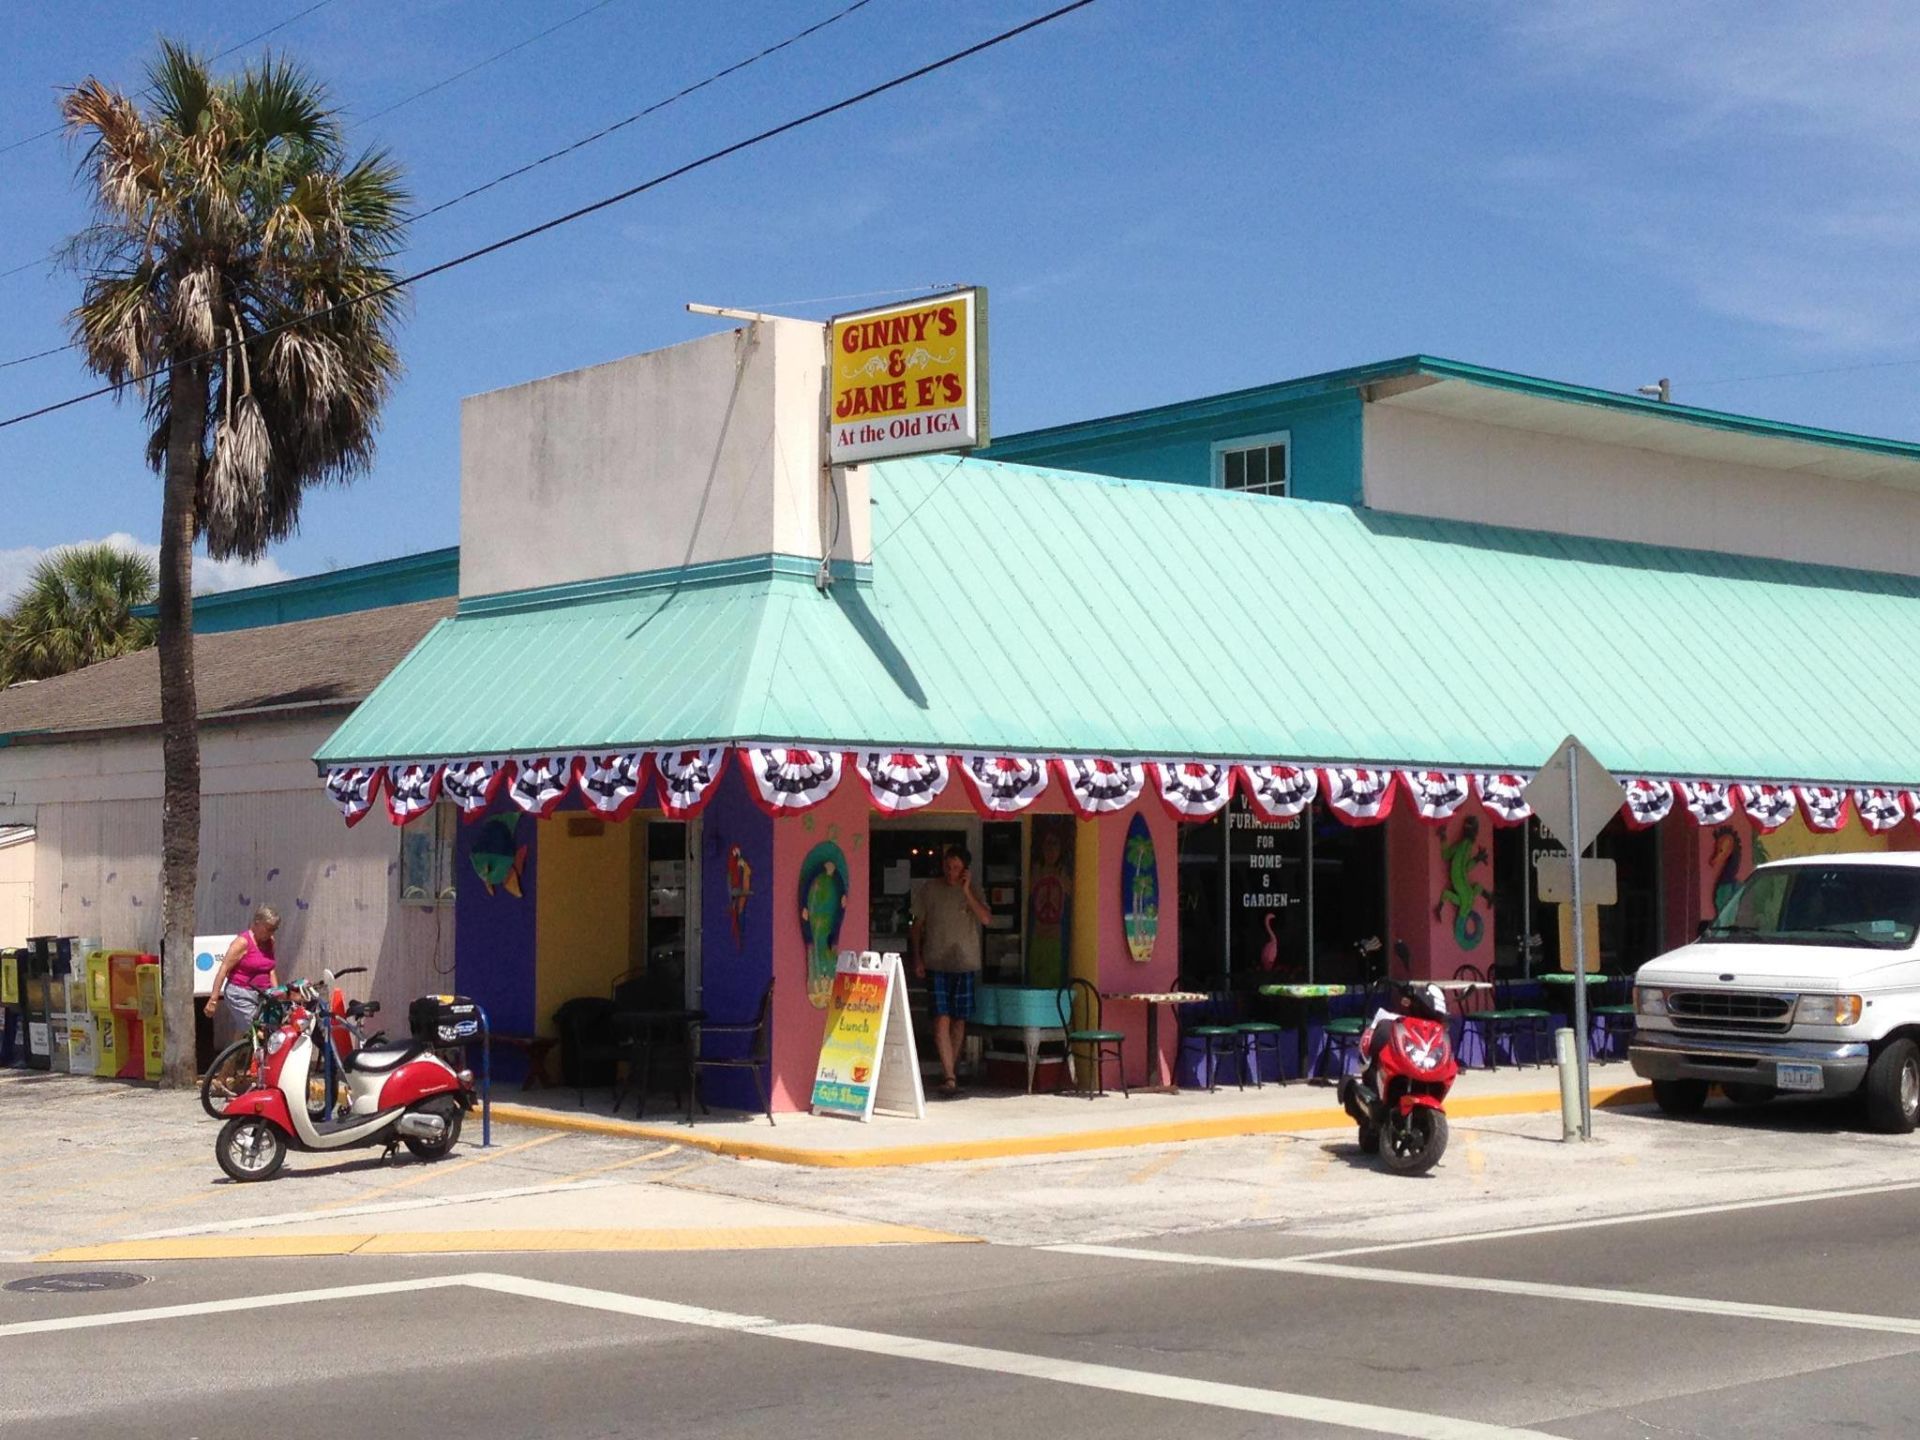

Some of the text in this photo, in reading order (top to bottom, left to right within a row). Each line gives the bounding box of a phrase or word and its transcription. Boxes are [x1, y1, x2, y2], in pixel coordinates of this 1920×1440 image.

[842, 307, 957, 353] GINNY'S
[888, 349, 906, 378] &
[836, 373, 963, 418] JANE E'S
[837, 413, 960, 447] At the Old IGA
[1257, 836, 1274, 848] FOR
[1250, 855, 1282, 868] HOME
[1262, 873, 1270, 888] &
[1243, 893, 1288, 907] GARDEN
[839, 1016, 869, 1033] Lunch
